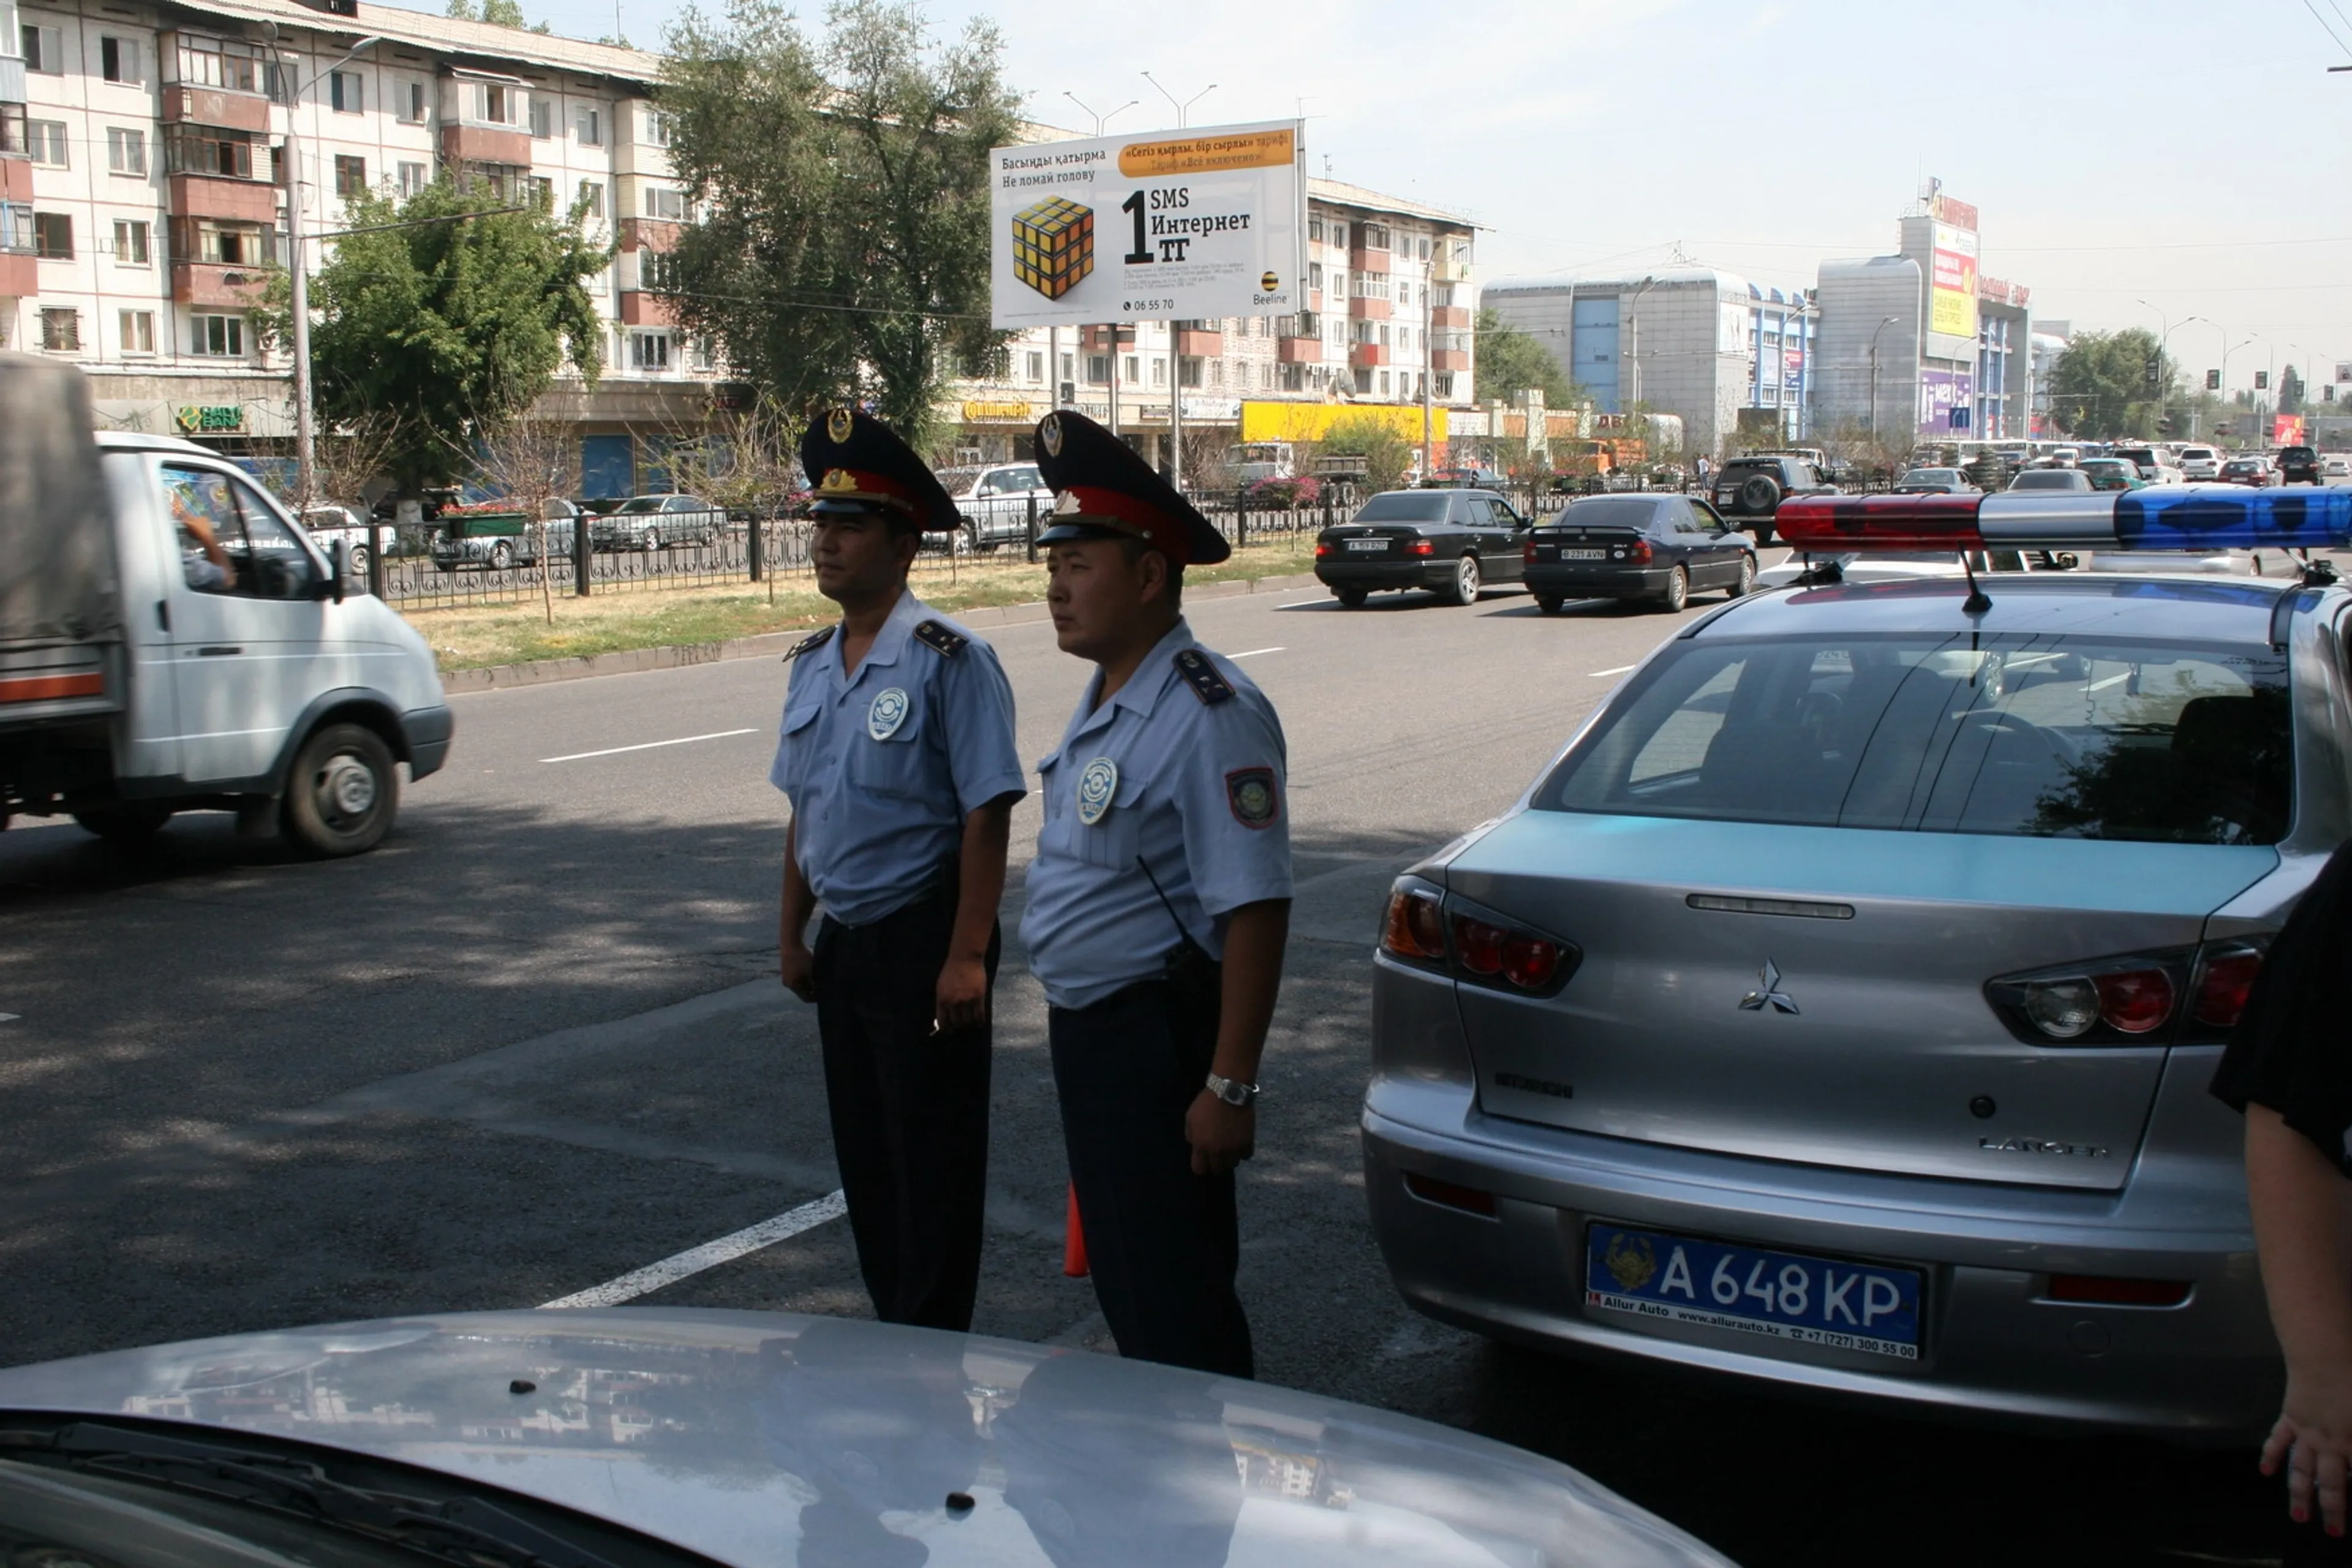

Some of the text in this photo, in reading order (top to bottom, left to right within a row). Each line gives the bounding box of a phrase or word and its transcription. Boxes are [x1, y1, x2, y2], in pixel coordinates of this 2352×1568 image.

[1055, 150, 1106, 165] қатырма
[1003, 170, 1095, 187] Не ломай голову
[1150, 187, 1189, 210] SMS
[1122, 190, 1154, 265] 1
[1152, 214, 1251, 237] Интернет
[1134, 299, 1174, 311] 06 55 70
[1253, 294, 1287, 305] Beeline
[203, 417, 241, 427] BANK
[1659, 1245, 1900, 1327] A 648 KP
[1604, 1297, 1635, 1311] Allur
[1638, 1302, 1669, 1316] Auto
[1677, 1311, 1781, 1335] www.allurauto.kz
[1807, 1331, 1821, 1342] +7
[1823, 1332, 1853, 1348] (727)
[1858, 1338, 1879, 1351] 300
[1882, 1342, 1896, 1354] 55
[1900, 1346, 1915, 1357] 00
